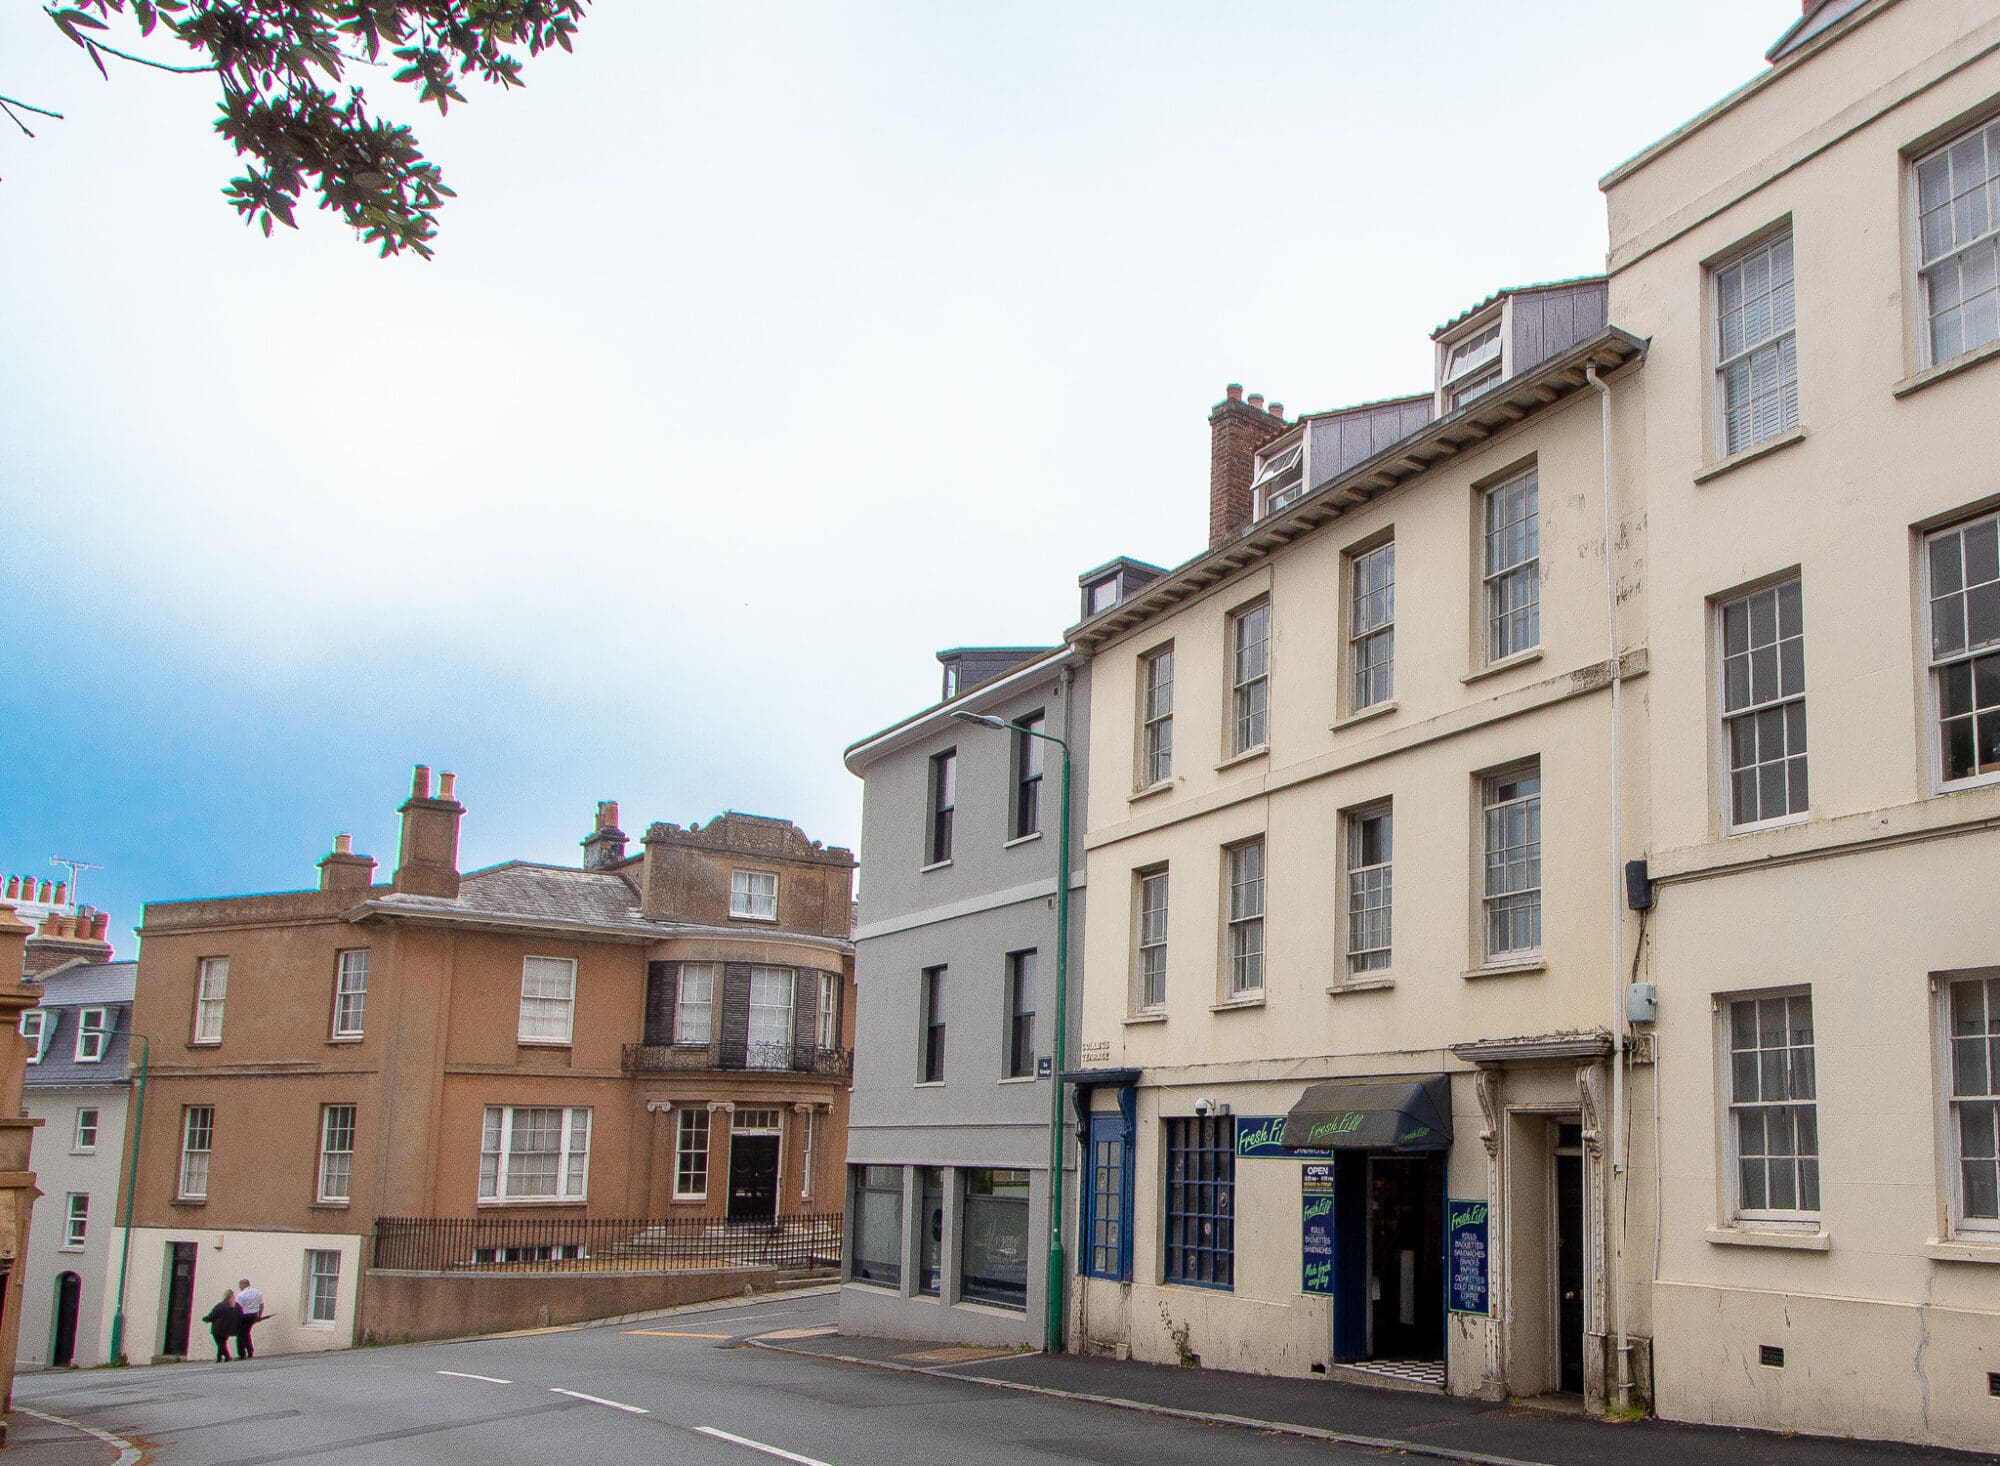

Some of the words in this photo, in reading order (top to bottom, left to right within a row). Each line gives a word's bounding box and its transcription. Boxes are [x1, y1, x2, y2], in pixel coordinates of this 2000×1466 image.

[1308, 1115, 1338, 1143] Fresh
[1338, 1111, 1364, 1132] Fill
[1237, 1125, 1268, 1155] Fresh
[1307, 1166, 1329, 1175] OPEN
[1304, 1200, 1319, 1222] Fresh
[1319, 1198, 1332, 1215] Fill
[1451, 1208, 1470, 1232] Fresh
[1471, 1204, 1487, 1224] Fill
[1310, 1226, 1325, 1234] ROLLS
[1461, 1232, 1478, 1240] ROLLS
[1455, 1240, 1484, 1249] BAGUETTES
[1304, 1245, 1332, 1255] SANDWICHES
[1454, 1249, 1486, 1258] SANDWICHES
[1454, 1283, 1467, 1291] COLD
[1461, 1292, 1478, 1300] COFFEE
[1465, 1301, 1476, 1309] TEA
